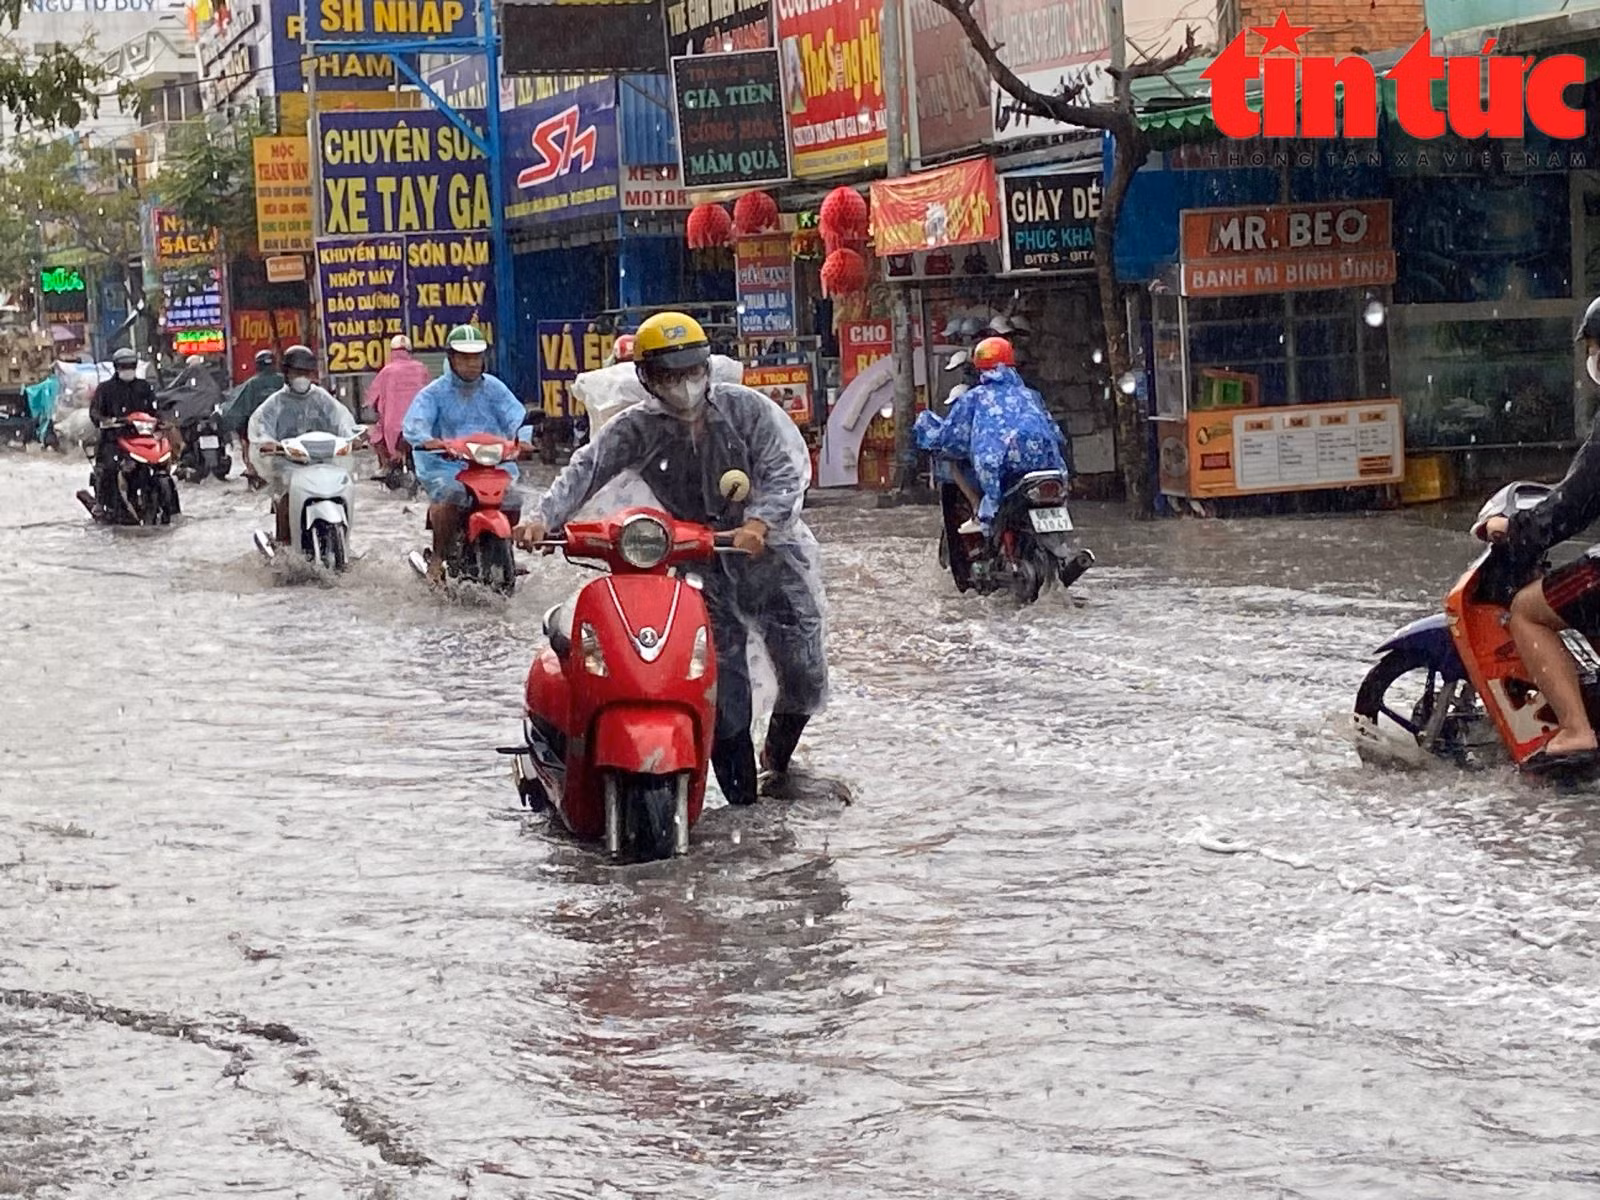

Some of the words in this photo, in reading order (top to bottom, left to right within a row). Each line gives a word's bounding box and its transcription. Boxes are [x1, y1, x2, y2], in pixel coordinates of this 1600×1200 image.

[319, 0, 364, 31] SH
[725, 79, 774, 106] TIÊN
[324, 120, 431, 165] CHUYÊN
[689, 148, 734, 176] MÂM
[738, 141, 780, 175] QUẢ
[326, 178, 369, 233] XE
[376, 175, 440, 232] TAY
[449, 173, 492, 229] GA
[625, 190, 687, 206] MOTOR
[1011, 181, 1063, 224] GIÀY
[1014, 225, 1058, 250] PHÚC
[1288, 209, 1368, 248] BEO
[368, 267, 395, 285] MÁY
[416, 283, 442, 307] XE
[445, 276, 486, 306] MÁY
[386, 318, 402, 333] XE
[849, 324, 886, 342] CHO
[328, 338, 391, 371] 250
[542, 379, 564, 418] XE
